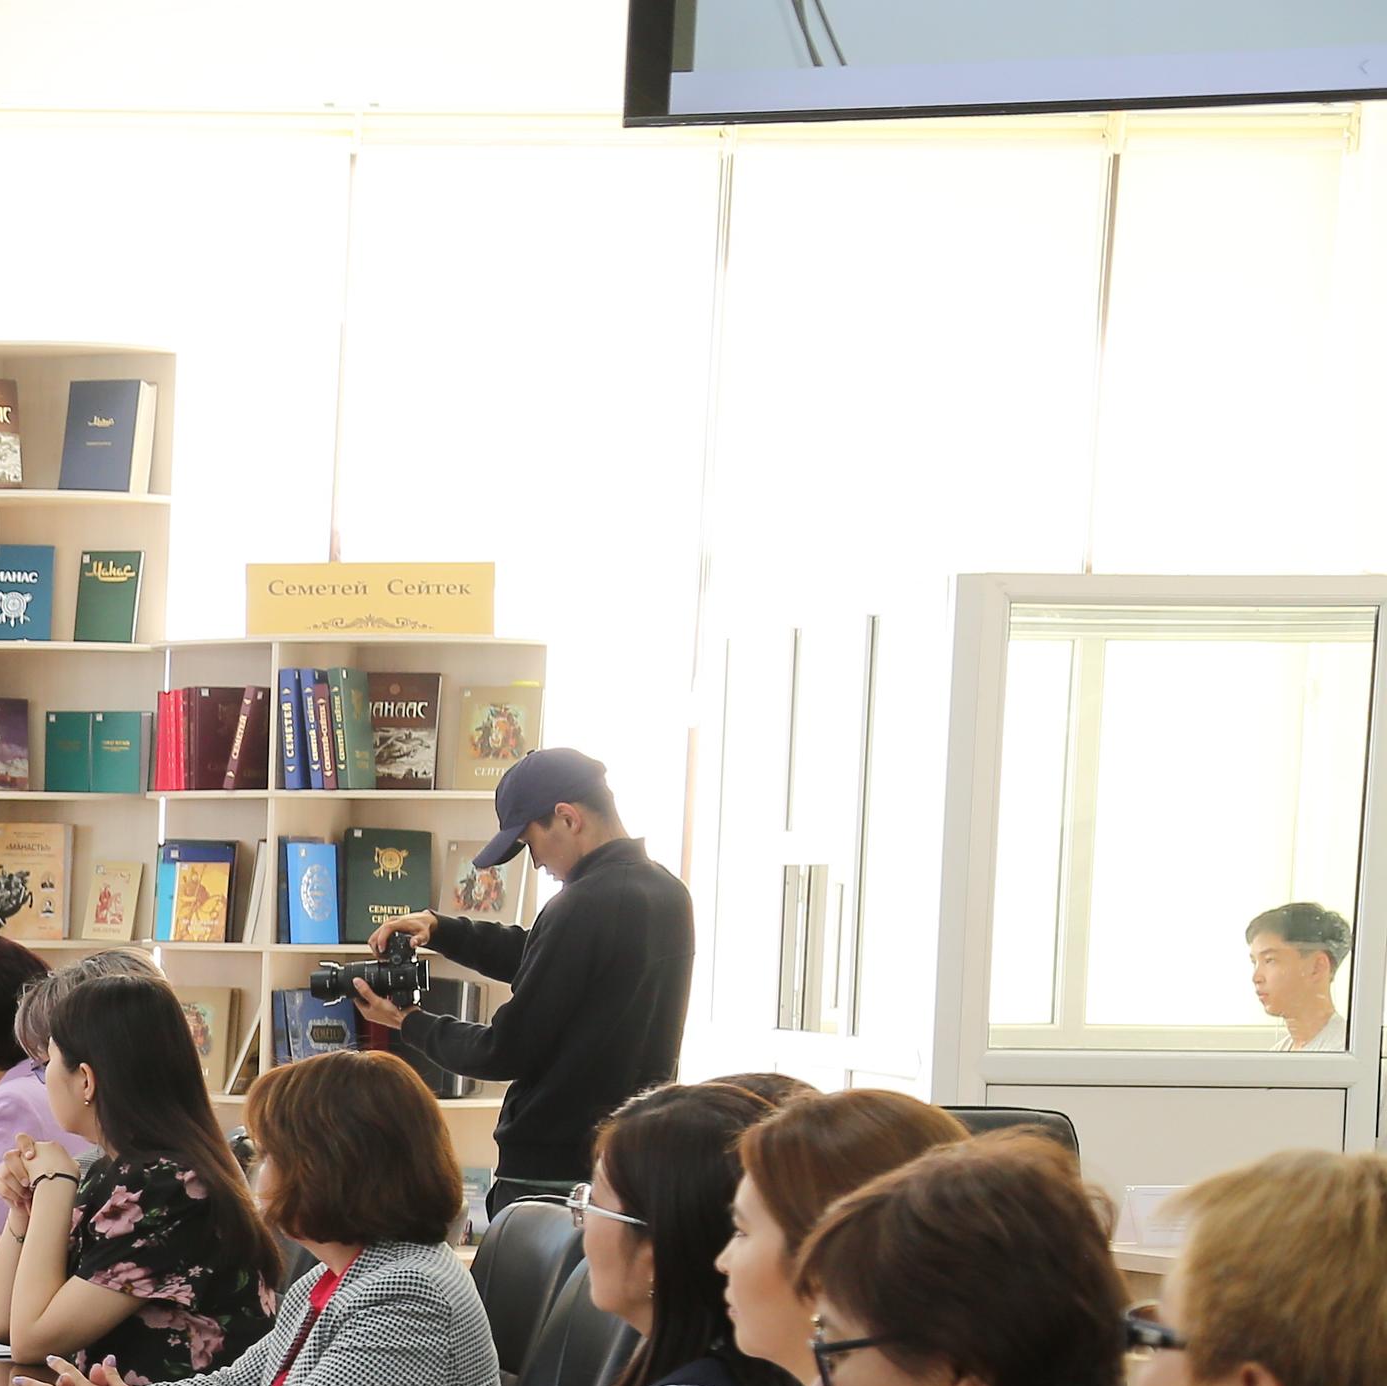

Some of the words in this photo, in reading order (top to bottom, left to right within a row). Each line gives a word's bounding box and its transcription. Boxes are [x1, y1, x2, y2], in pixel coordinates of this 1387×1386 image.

[267, 578, 369, 597] Семетей
[386, 578, 473, 597] Сейтек
[369, 701, 429, 720] АНААС
[281, 702, 295, 758] СЕМЕТЕЙ
